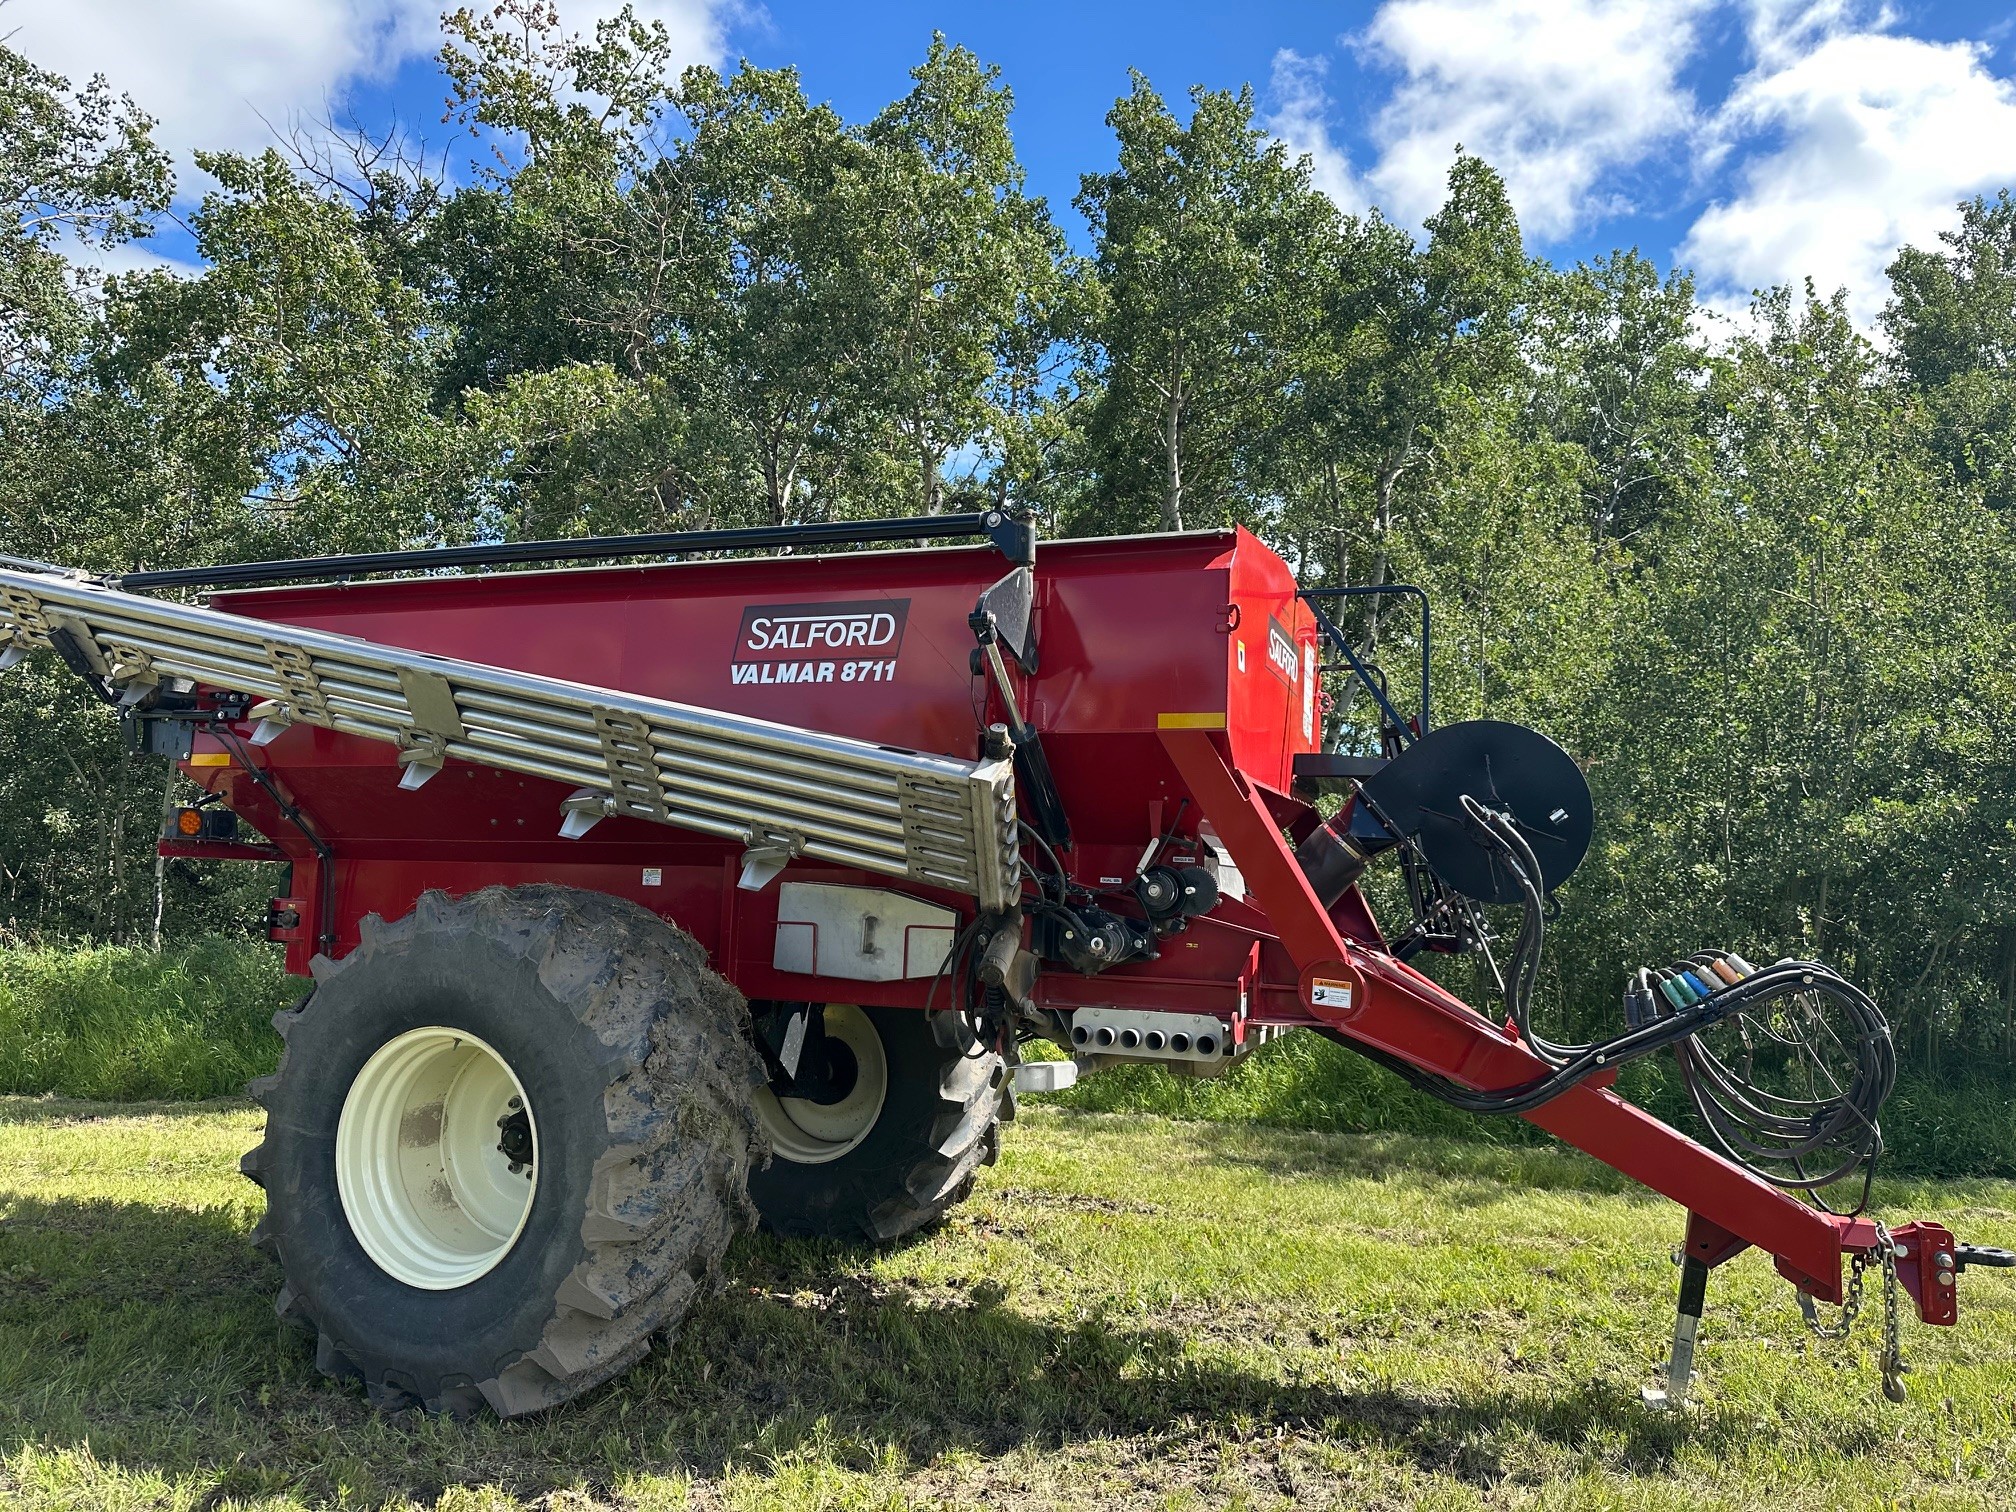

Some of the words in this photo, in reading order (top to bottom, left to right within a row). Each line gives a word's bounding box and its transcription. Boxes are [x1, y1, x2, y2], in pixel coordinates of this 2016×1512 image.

[747, 613, 896, 651] SALFORD
[730, 661, 836, 685] VALMAR
[840, 660, 897, 682] 8711
[1268, 628, 1299, 683] SALFORD
